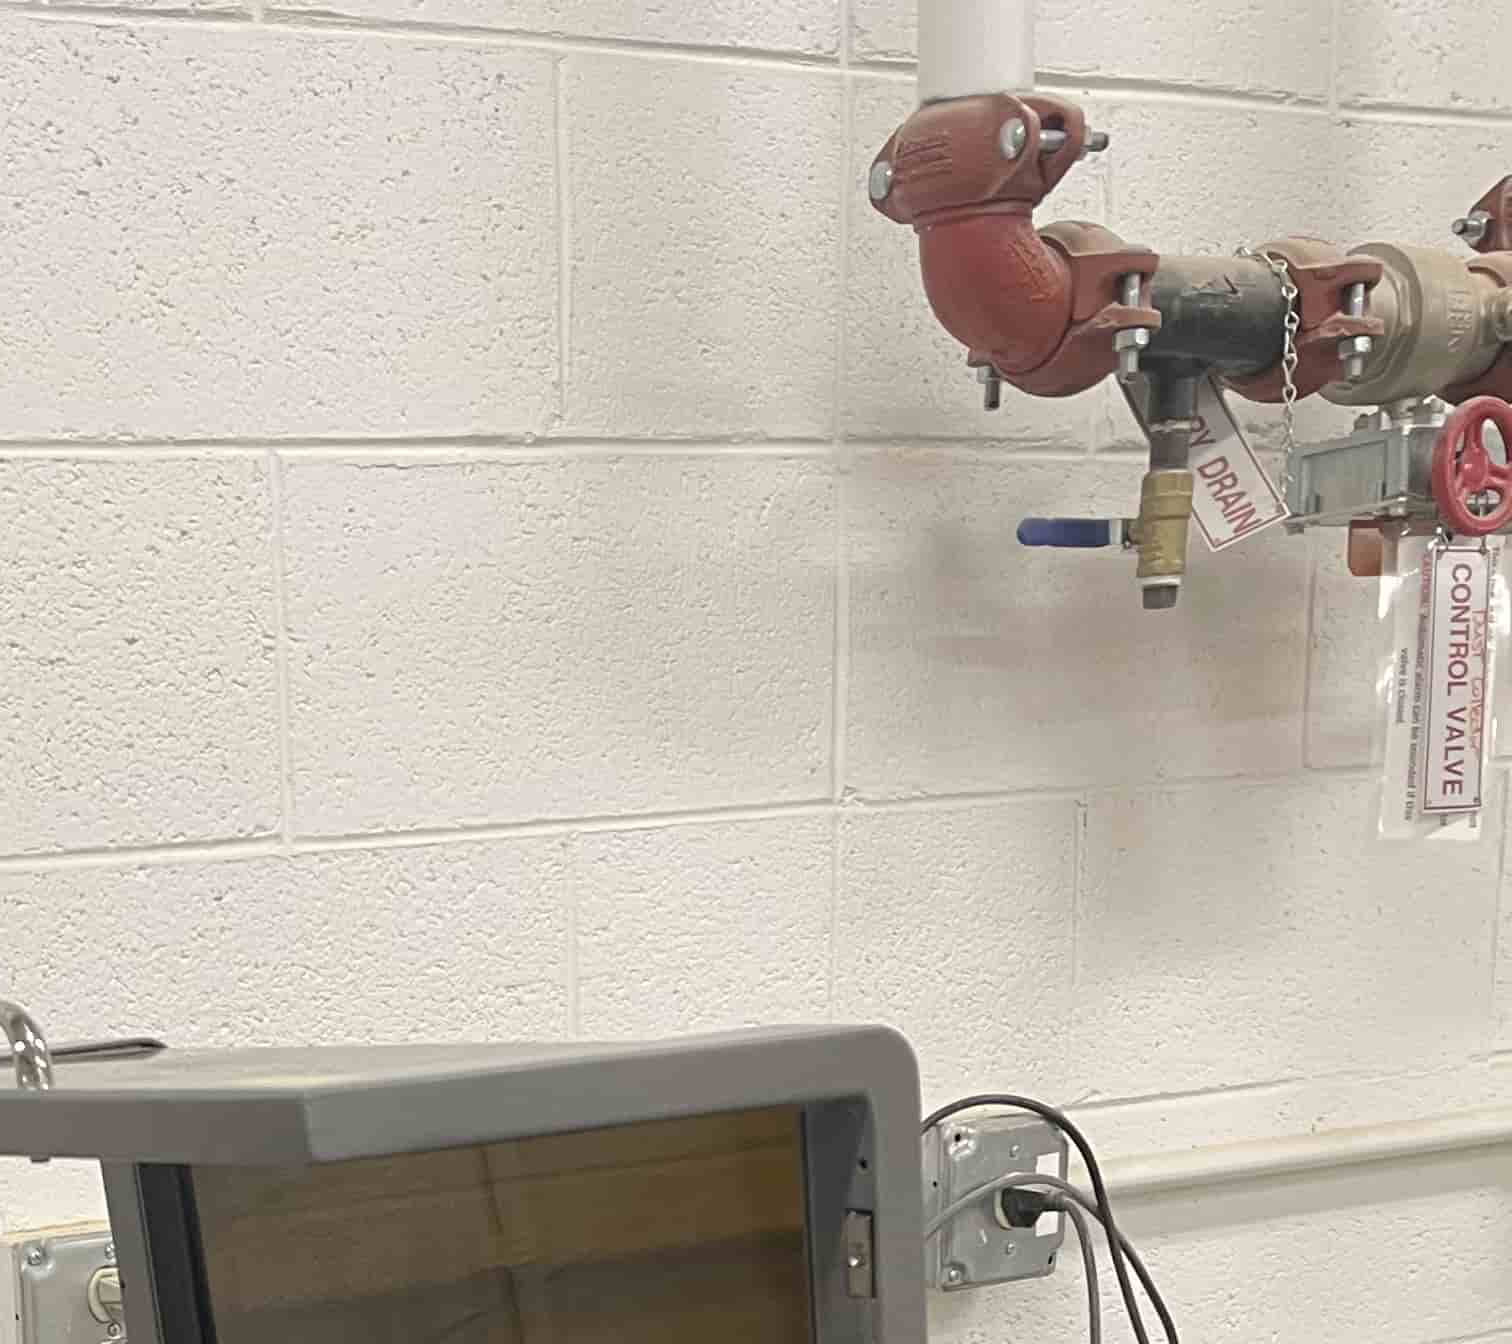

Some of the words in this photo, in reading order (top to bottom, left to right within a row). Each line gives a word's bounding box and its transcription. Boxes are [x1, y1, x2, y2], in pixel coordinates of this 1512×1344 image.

[1197, 455, 1263, 534] DRAIN
[1414, 614, 1428, 669] Automatic
[1447, 564, 1472, 696] CONTROL
[1398, 648, 1408, 674] valve
[1413, 672, 1425, 702] alarm
[1412, 705, 1422, 724] can
[1410, 727, 1420, 740] be
[1443, 707, 1466, 796] VALVE
[1404, 800, 1415, 820] this
